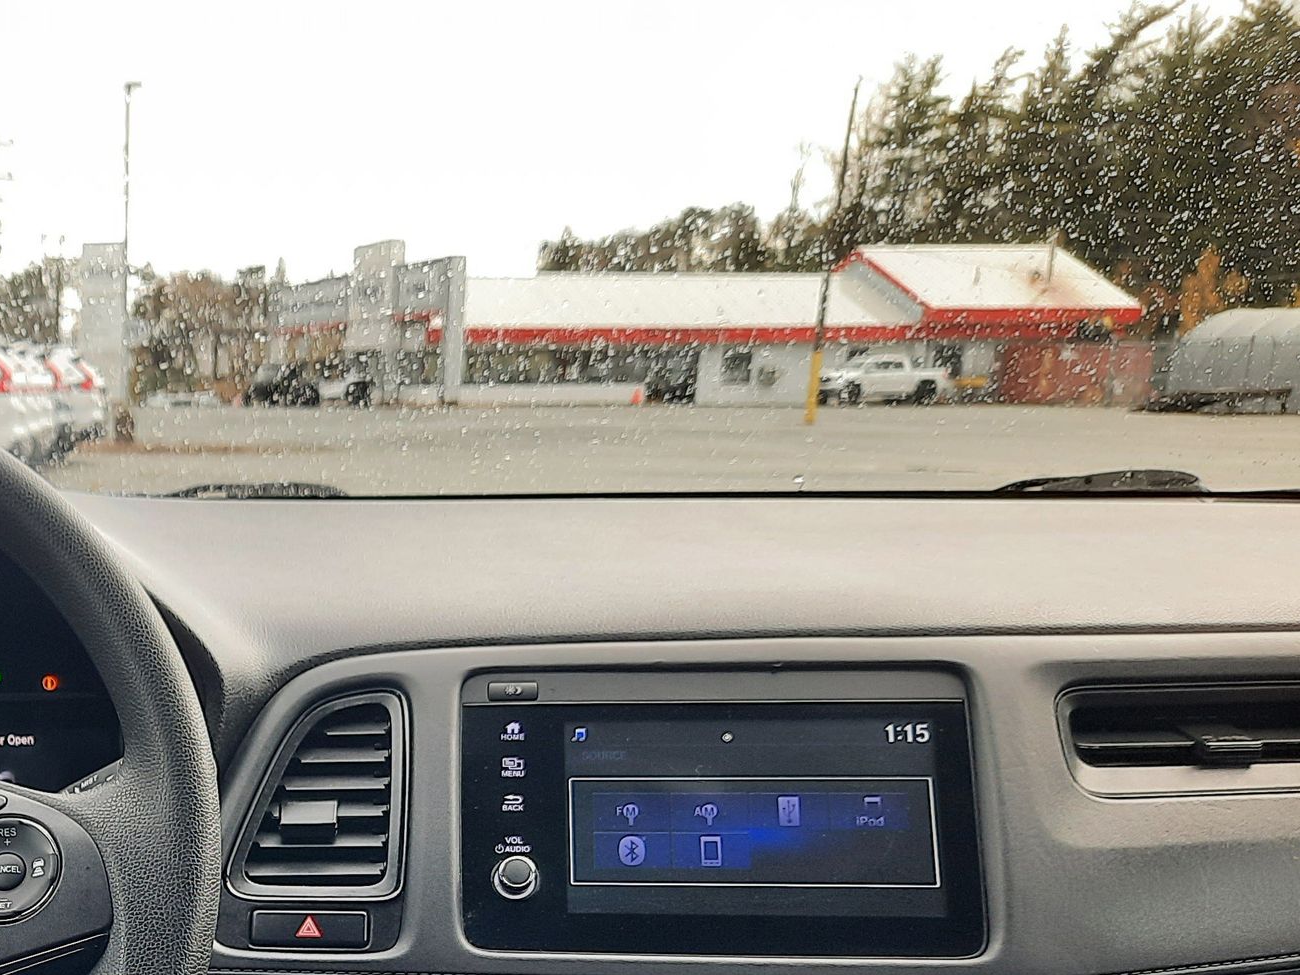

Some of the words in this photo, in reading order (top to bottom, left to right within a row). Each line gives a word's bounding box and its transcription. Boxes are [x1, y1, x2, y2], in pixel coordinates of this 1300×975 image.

[500, 733, 525, 741] HOME
[884, 723, 931, 743] 1:15
[7, 734, 35, 747] Open
[80, 774, 98, 789] MIST
[855, 815, 885, 827] iPod
[505, 836, 524, 844] VOL
[505, 845, 531, 853] AUDIO
